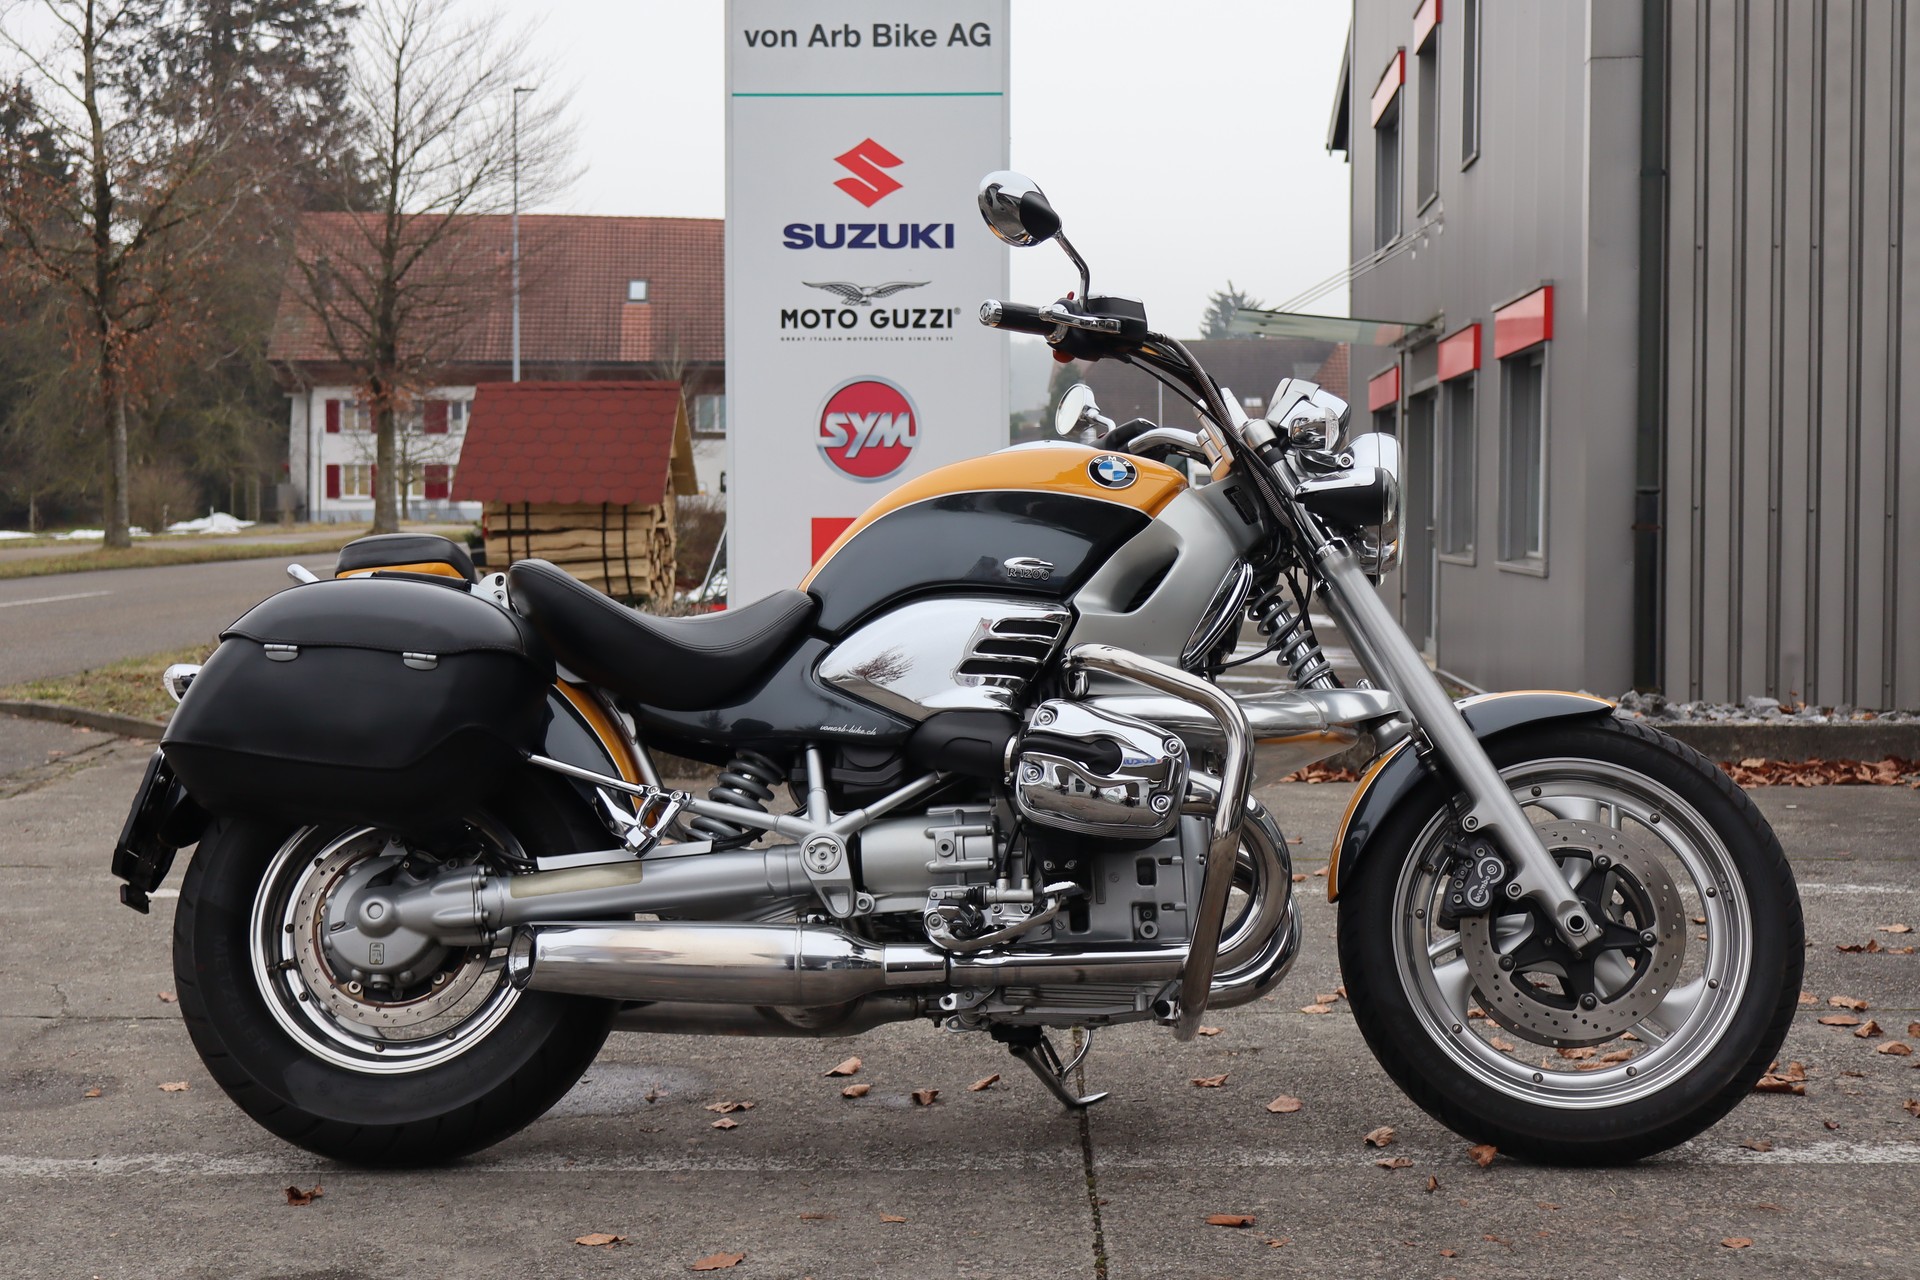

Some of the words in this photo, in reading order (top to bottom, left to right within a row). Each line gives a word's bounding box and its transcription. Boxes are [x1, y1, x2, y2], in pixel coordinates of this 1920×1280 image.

[744, 29, 798, 48] von
[807, 23, 861, 48] Arb
[872, 23, 938, 48] Bike
[946, 22, 992, 48] AG
[782, 222, 955, 250] SUZUKI
[781, 308, 858, 329] MOTO
[819, 412, 916, 459] SYM
[1093, 455, 1132, 467] BMW
[1007, 567, 1017, 577] R
[1020, 568, 1050, 581] 1200
[1473, 875, 1491, 902] brembo
[213, 934, 272, 1055] METZELER
